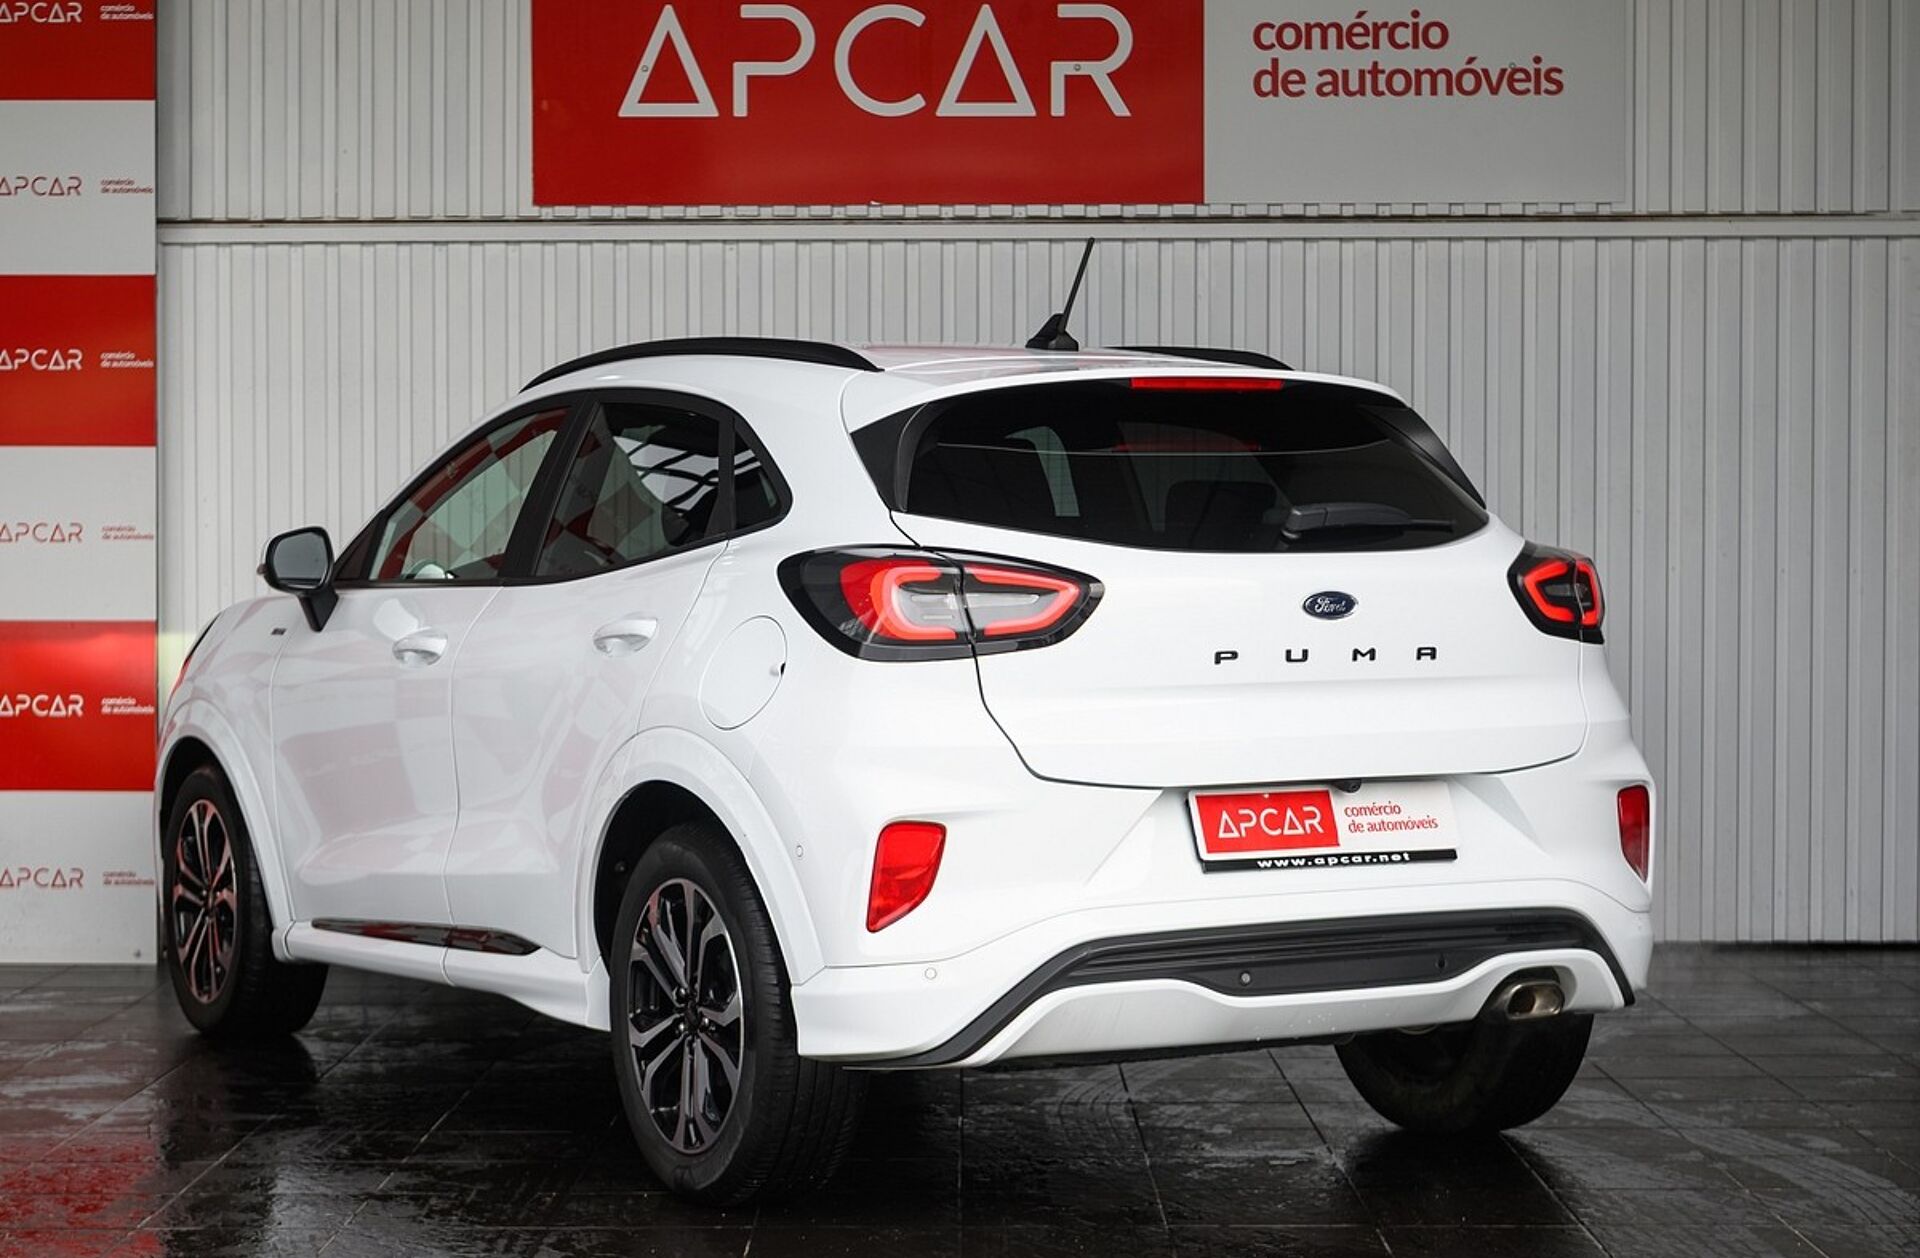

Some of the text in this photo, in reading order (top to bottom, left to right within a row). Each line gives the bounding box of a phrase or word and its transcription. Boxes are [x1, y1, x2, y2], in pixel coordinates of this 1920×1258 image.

[0, 2, 83, 23] APCAR
[1252, 9, 1449, 51] comércio
[617, 3, 1134, 118] APCAR
[1253, 55, 1564, 98] de automóveis
[0, 176, 83, 196] APCAR
[0, 348, 83, 371] APCAR
[0, 522, 84, 543] APCAR
[1314, 596, 1347, 613] Ford
[1214, 647, 1437, 665] PUMA
[0, 694, 84, 718] APCAR
[1344, 801, 1402, 818] comércio
[1218, 806, 1324, 838] APCAR
[1348, 814, 1439, 833] de automóveis
[1257, 851, 1411, 869] www.apcar.net
[0, 867, 84, 888] APCAR
